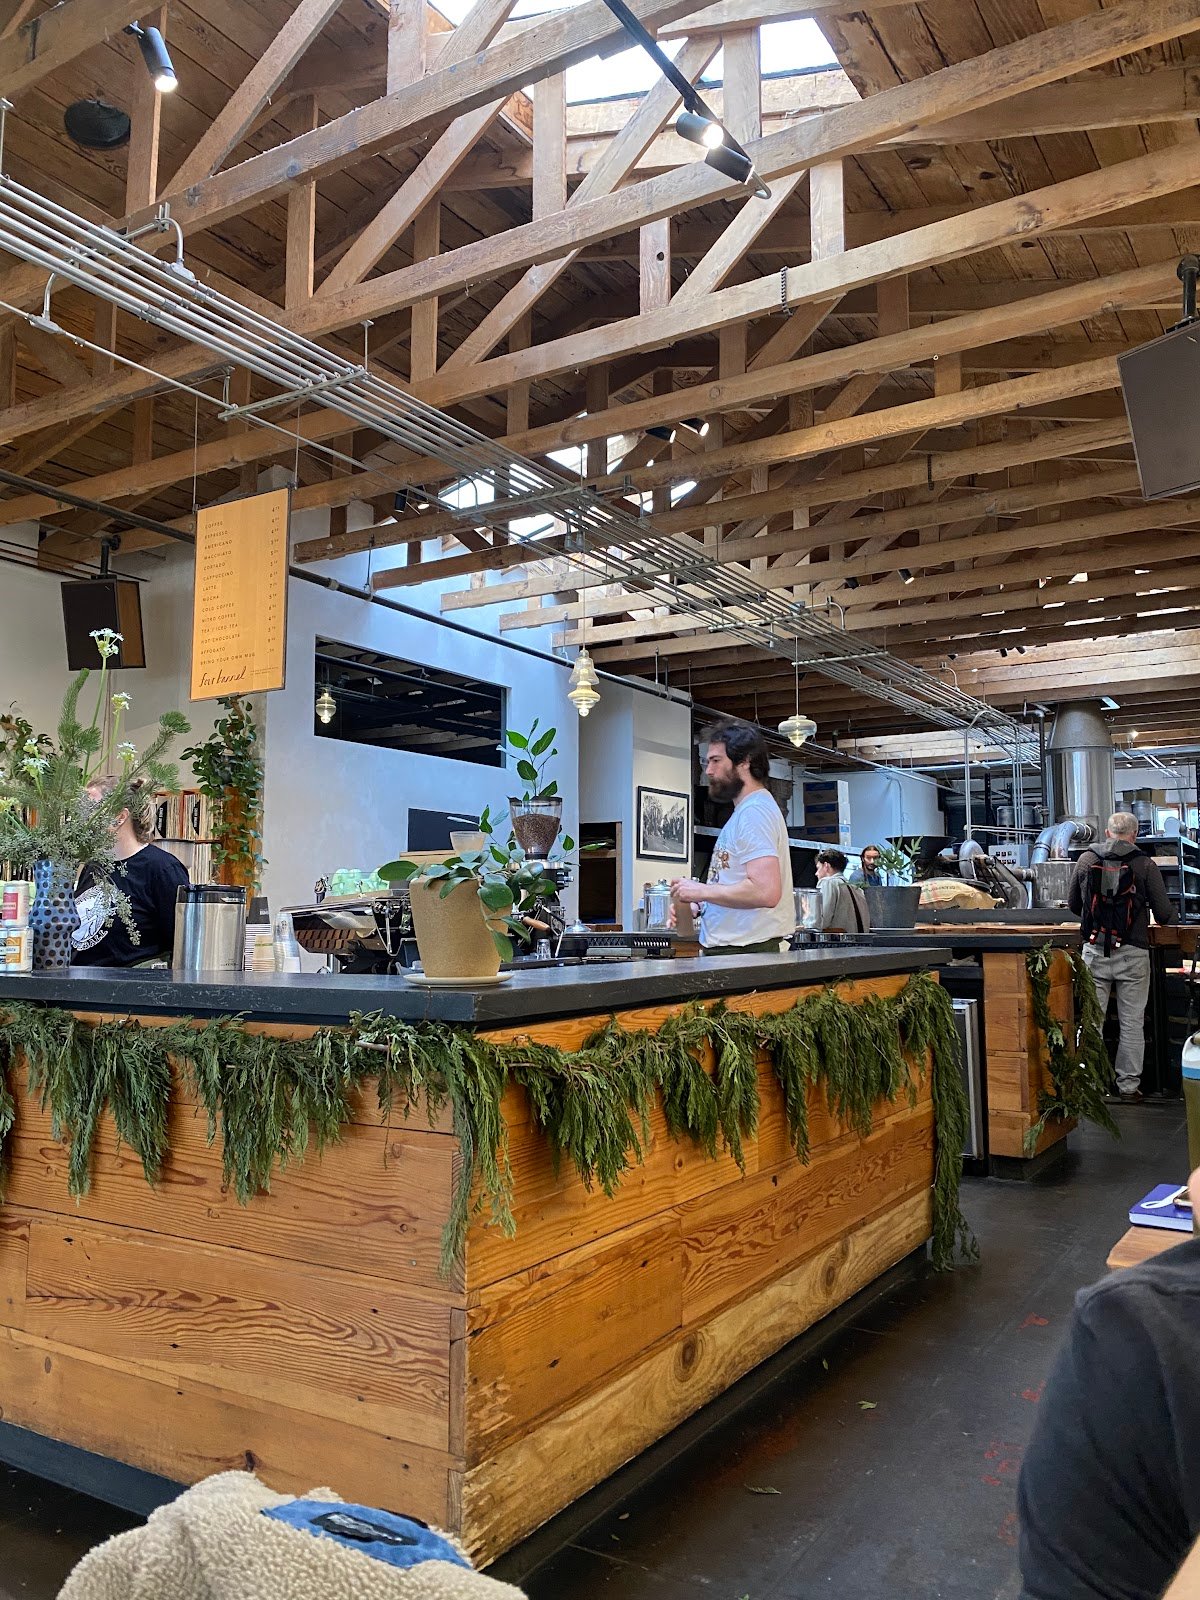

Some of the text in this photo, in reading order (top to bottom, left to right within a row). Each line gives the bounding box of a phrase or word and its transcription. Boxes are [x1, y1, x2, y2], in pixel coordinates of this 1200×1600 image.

[205, 521, 223, 529] COFFEE
[205, 530, 228, 540] ESPRESSO
[204, 540, 233, 550] AMERICANO
[204, 551, 232, 560] MACCHIATO
[204, 562, 226, 571] CORTADO
[203, 571, 234, 581] CAPPUCCINO
[212, 634, 240, 643] CHOCOLATE
[201, 647, 226, 655] AFFOGATO
